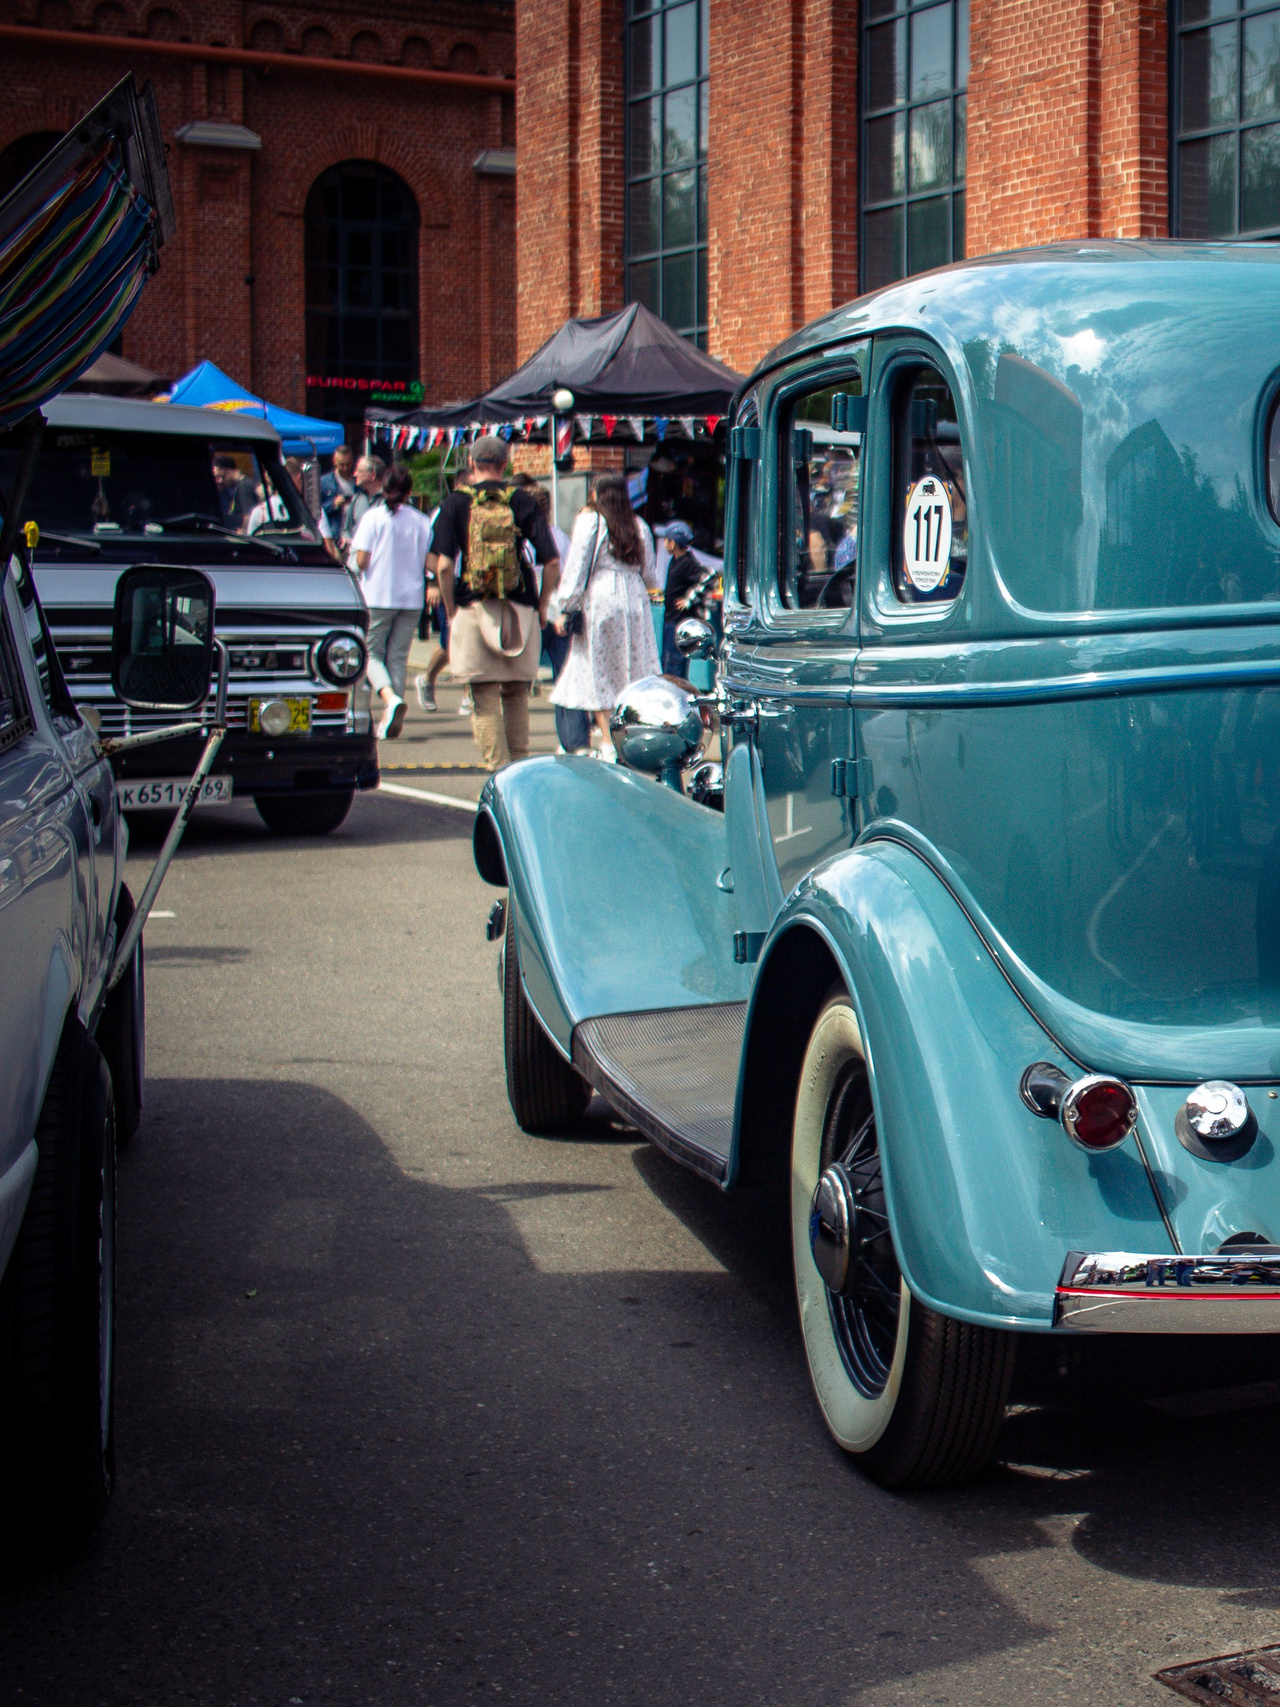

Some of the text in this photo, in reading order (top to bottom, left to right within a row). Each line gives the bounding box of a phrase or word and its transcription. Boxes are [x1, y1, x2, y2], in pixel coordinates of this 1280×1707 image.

[306, 375, 405, 391] EUROSPAR
[913, 505, 944, 562] 117
[204, 781, 224, 796] 69
